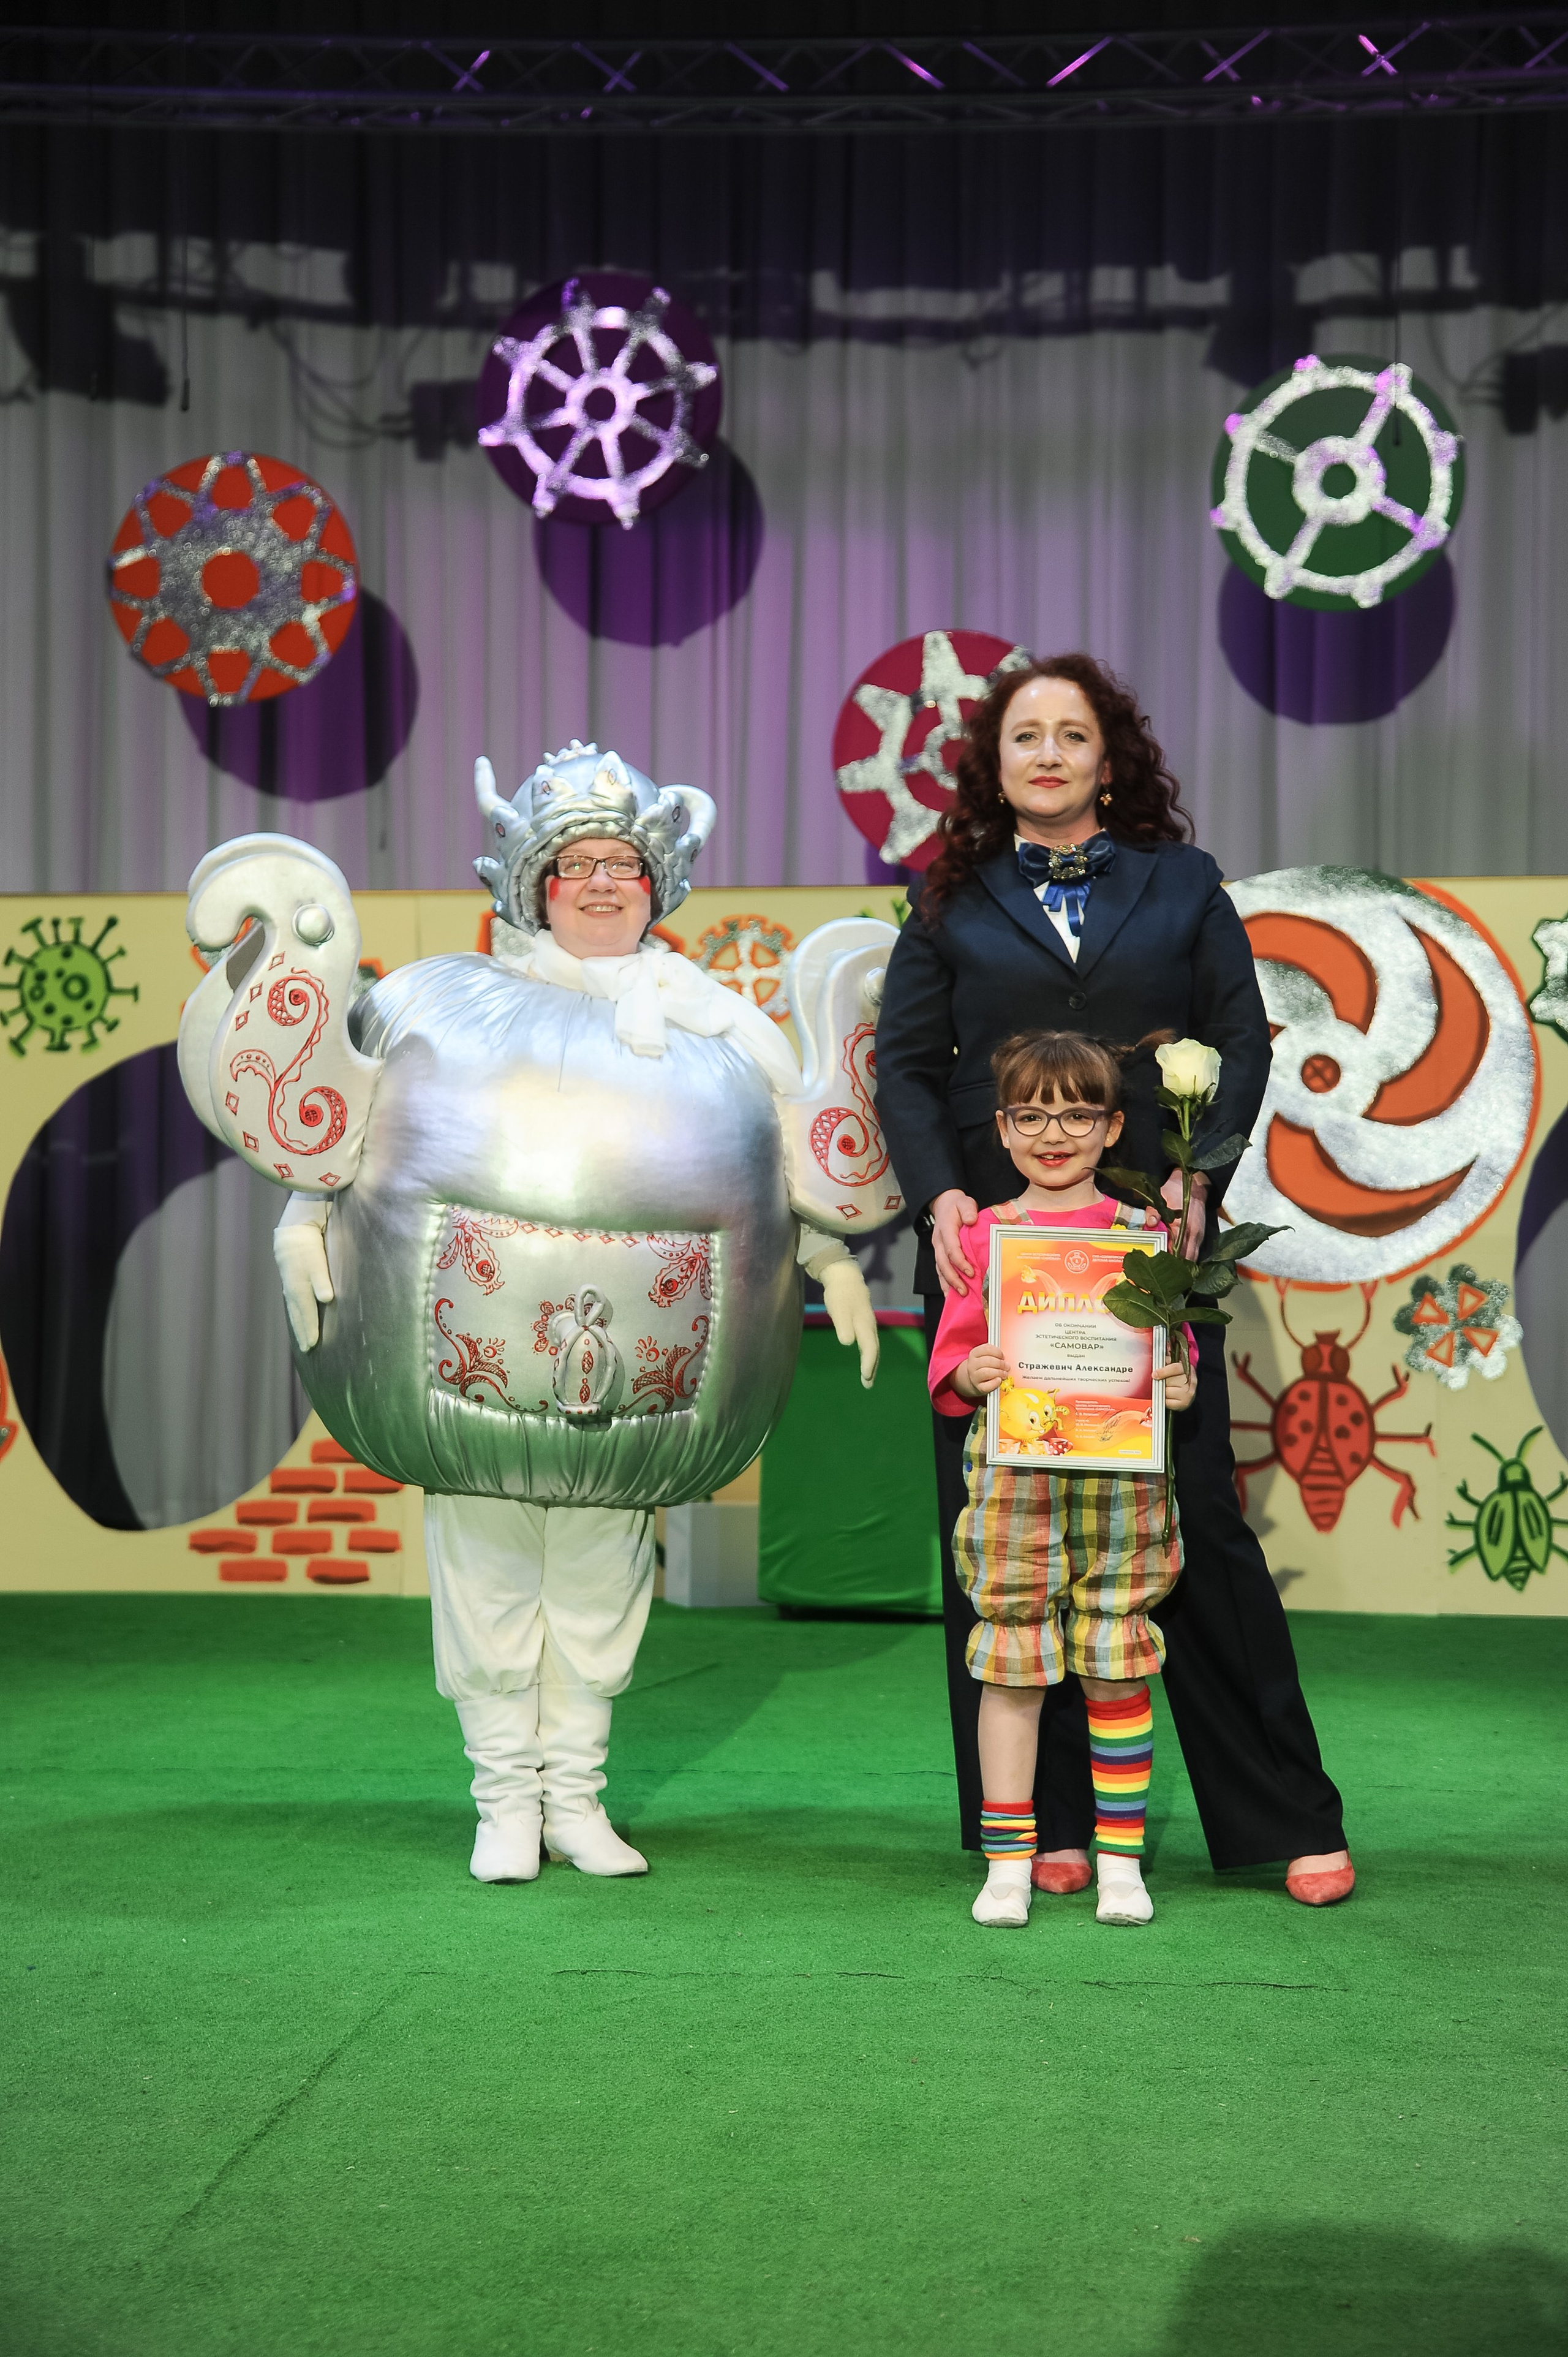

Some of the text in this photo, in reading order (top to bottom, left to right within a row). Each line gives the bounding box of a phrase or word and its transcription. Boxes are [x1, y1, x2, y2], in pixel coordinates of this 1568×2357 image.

[1017, 1291, 1110, 1314] ДИПЛО
[1018, 1361, 1133, 1374] Стражевич Александре
